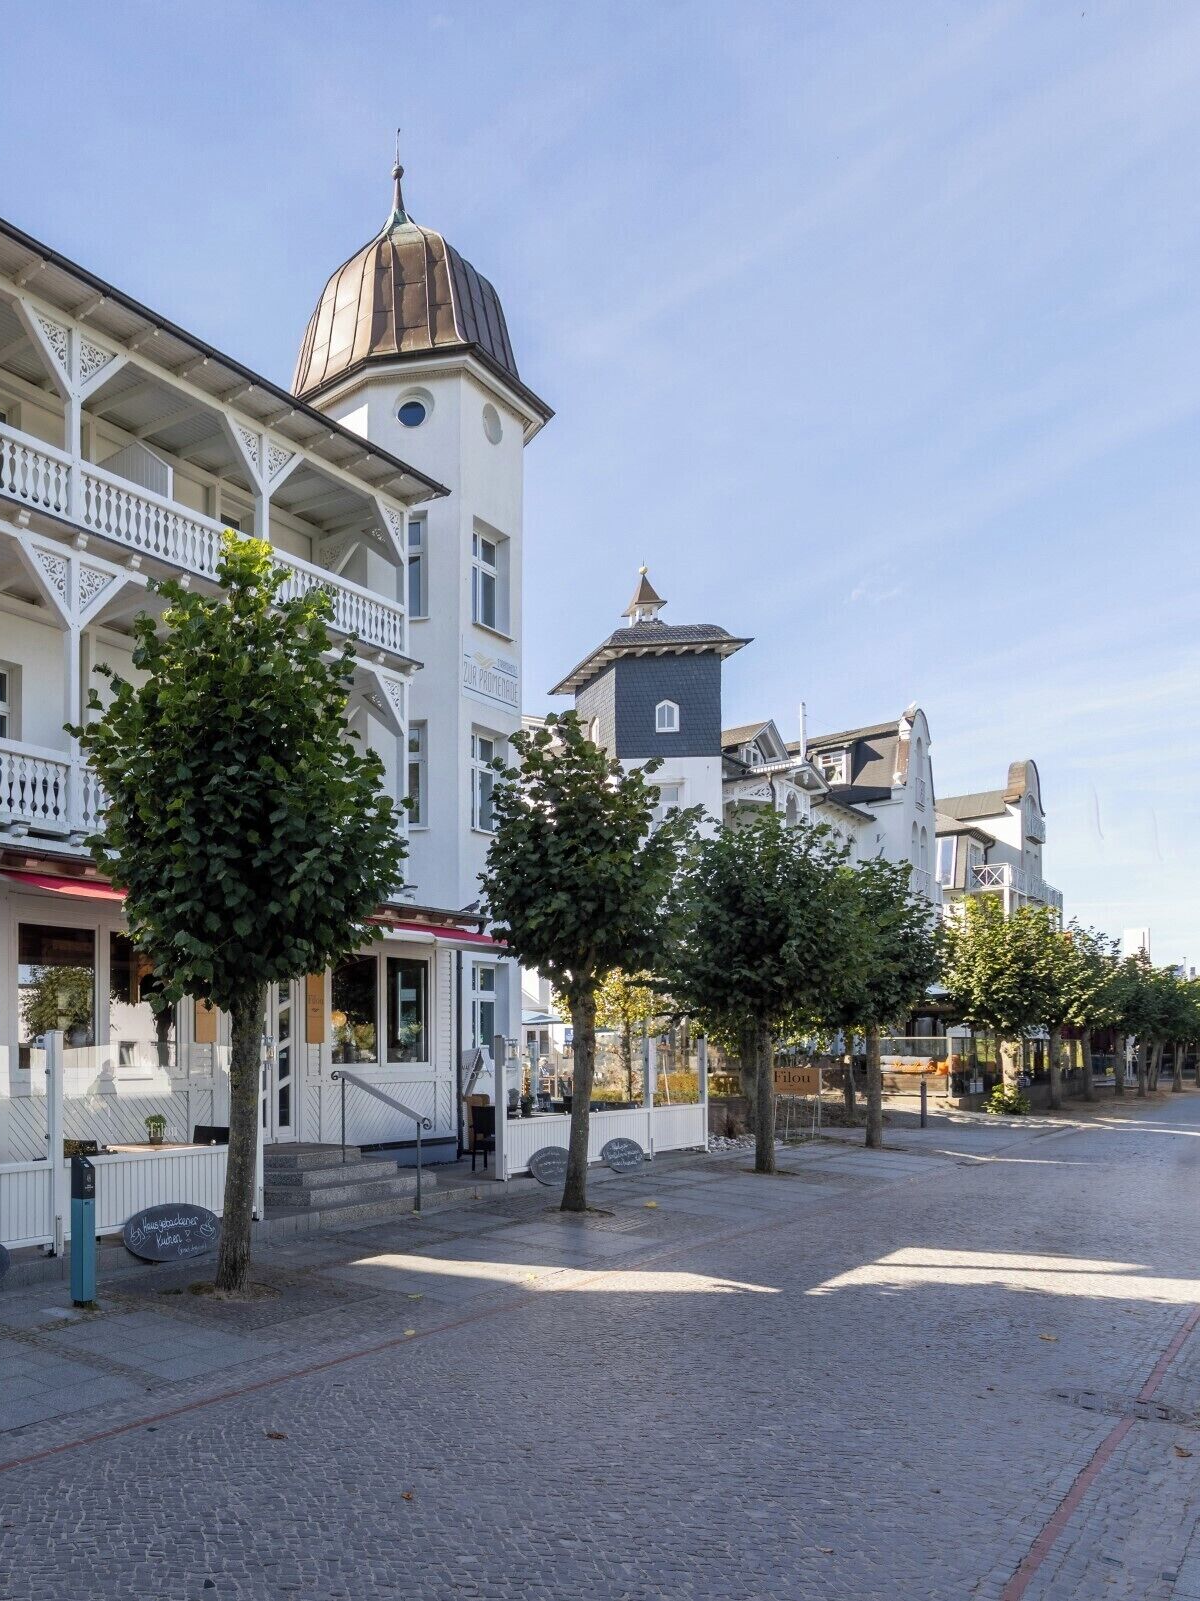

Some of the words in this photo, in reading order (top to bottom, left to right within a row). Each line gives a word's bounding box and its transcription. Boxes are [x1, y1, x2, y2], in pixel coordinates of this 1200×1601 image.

[463, 660, 477, 687] ZUR
[479, 668, 519, 703] PROMENADE
[774, 1071, 811, 1083] Filou
